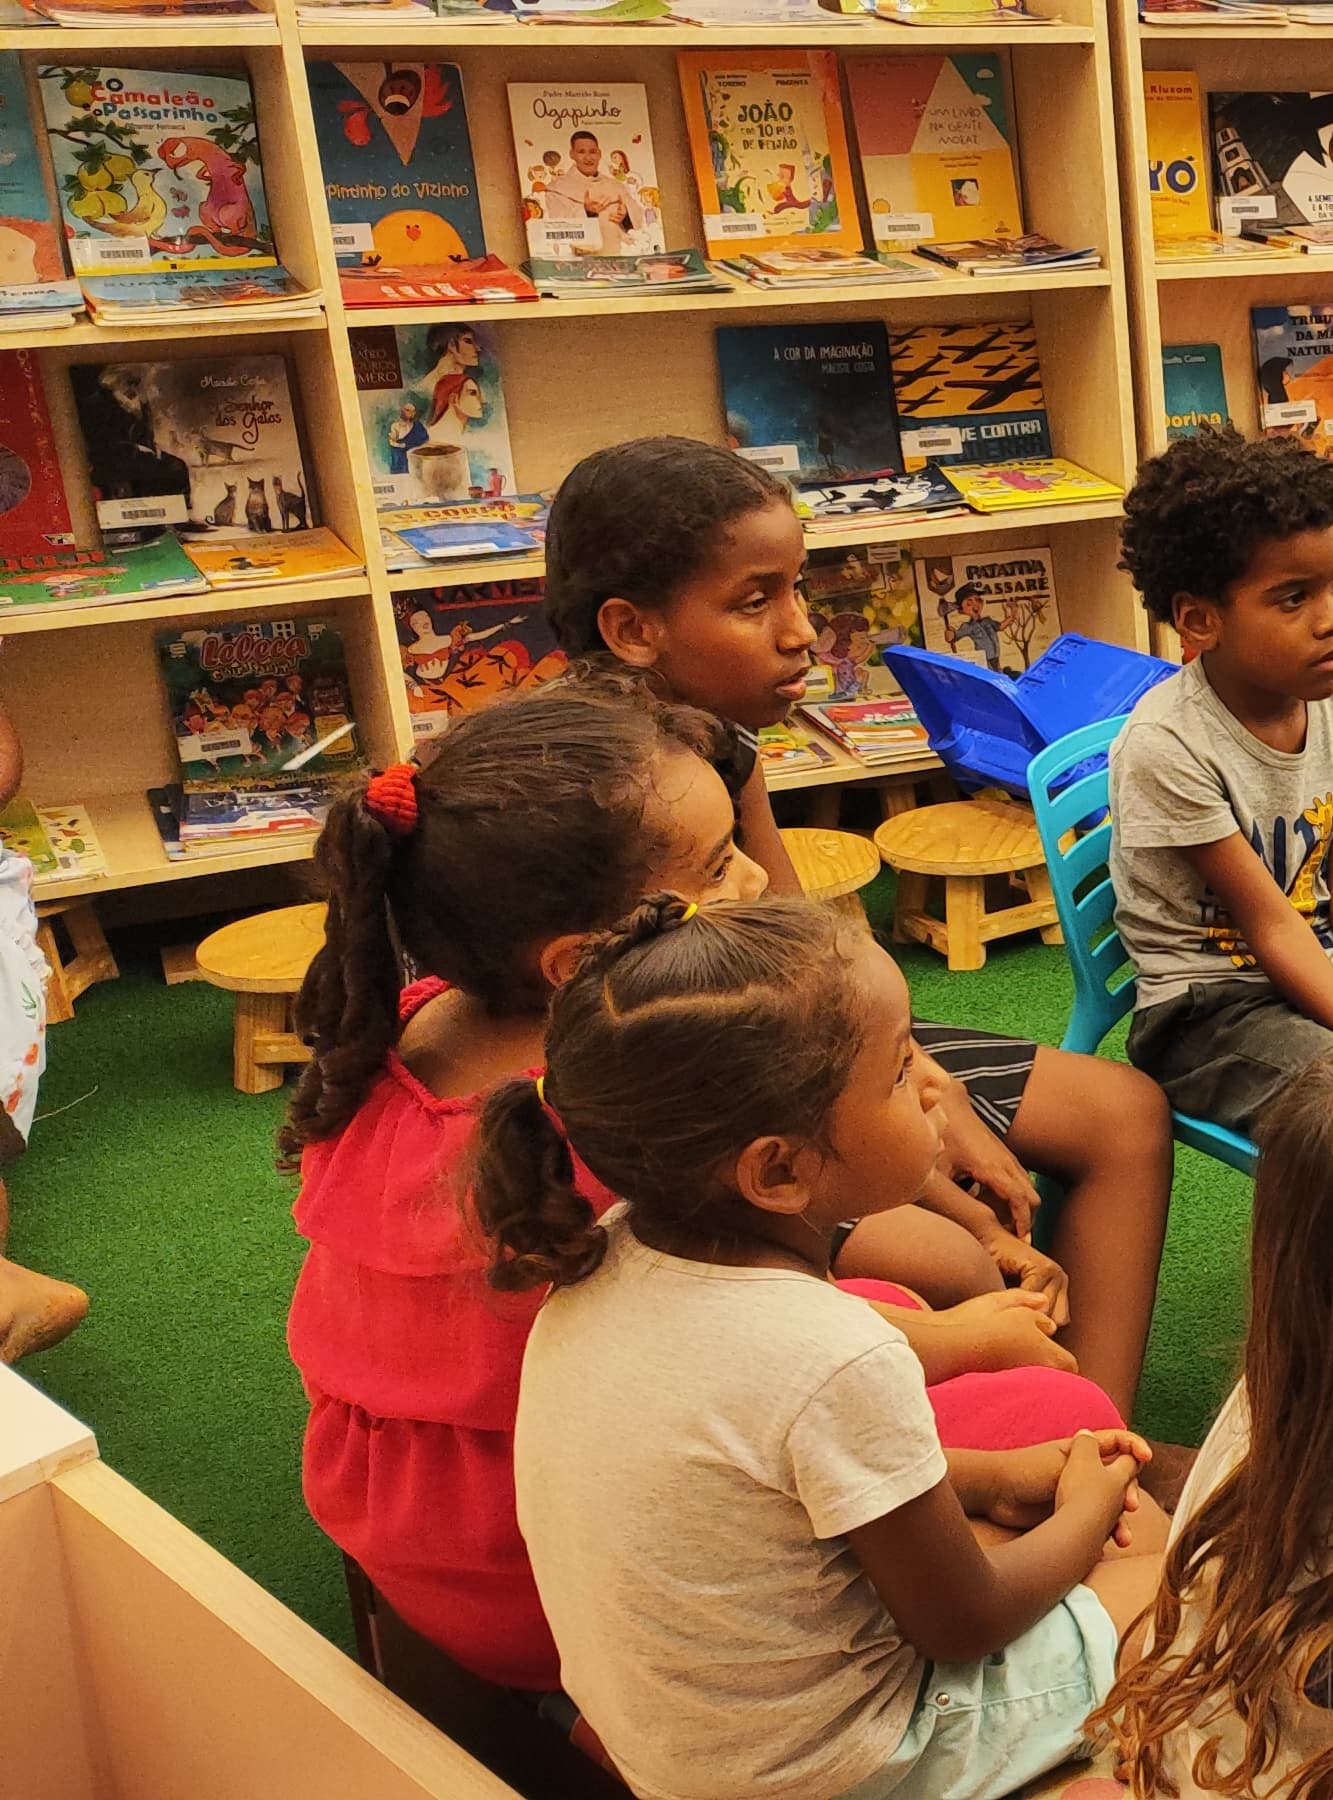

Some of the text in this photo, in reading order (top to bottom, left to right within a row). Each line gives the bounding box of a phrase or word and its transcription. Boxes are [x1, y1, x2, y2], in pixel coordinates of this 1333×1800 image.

[90, 81, 215, 108] Camaleão
[106, 78, 123, 92] O
[103, 102, 218, 123] Passarinho
[533, 98, 622, 129] Agapinho
[737, 99, 793, 124] JOÃO
[757, 123, 773, 138] 10
[1295, 330, 1314, 342] DA
[773, 342, 874, 361] A COR DA IMAGINAÇÃO
[215, 411, 236, 427] dos
[981, 418, 1042, 440] CONTRA
